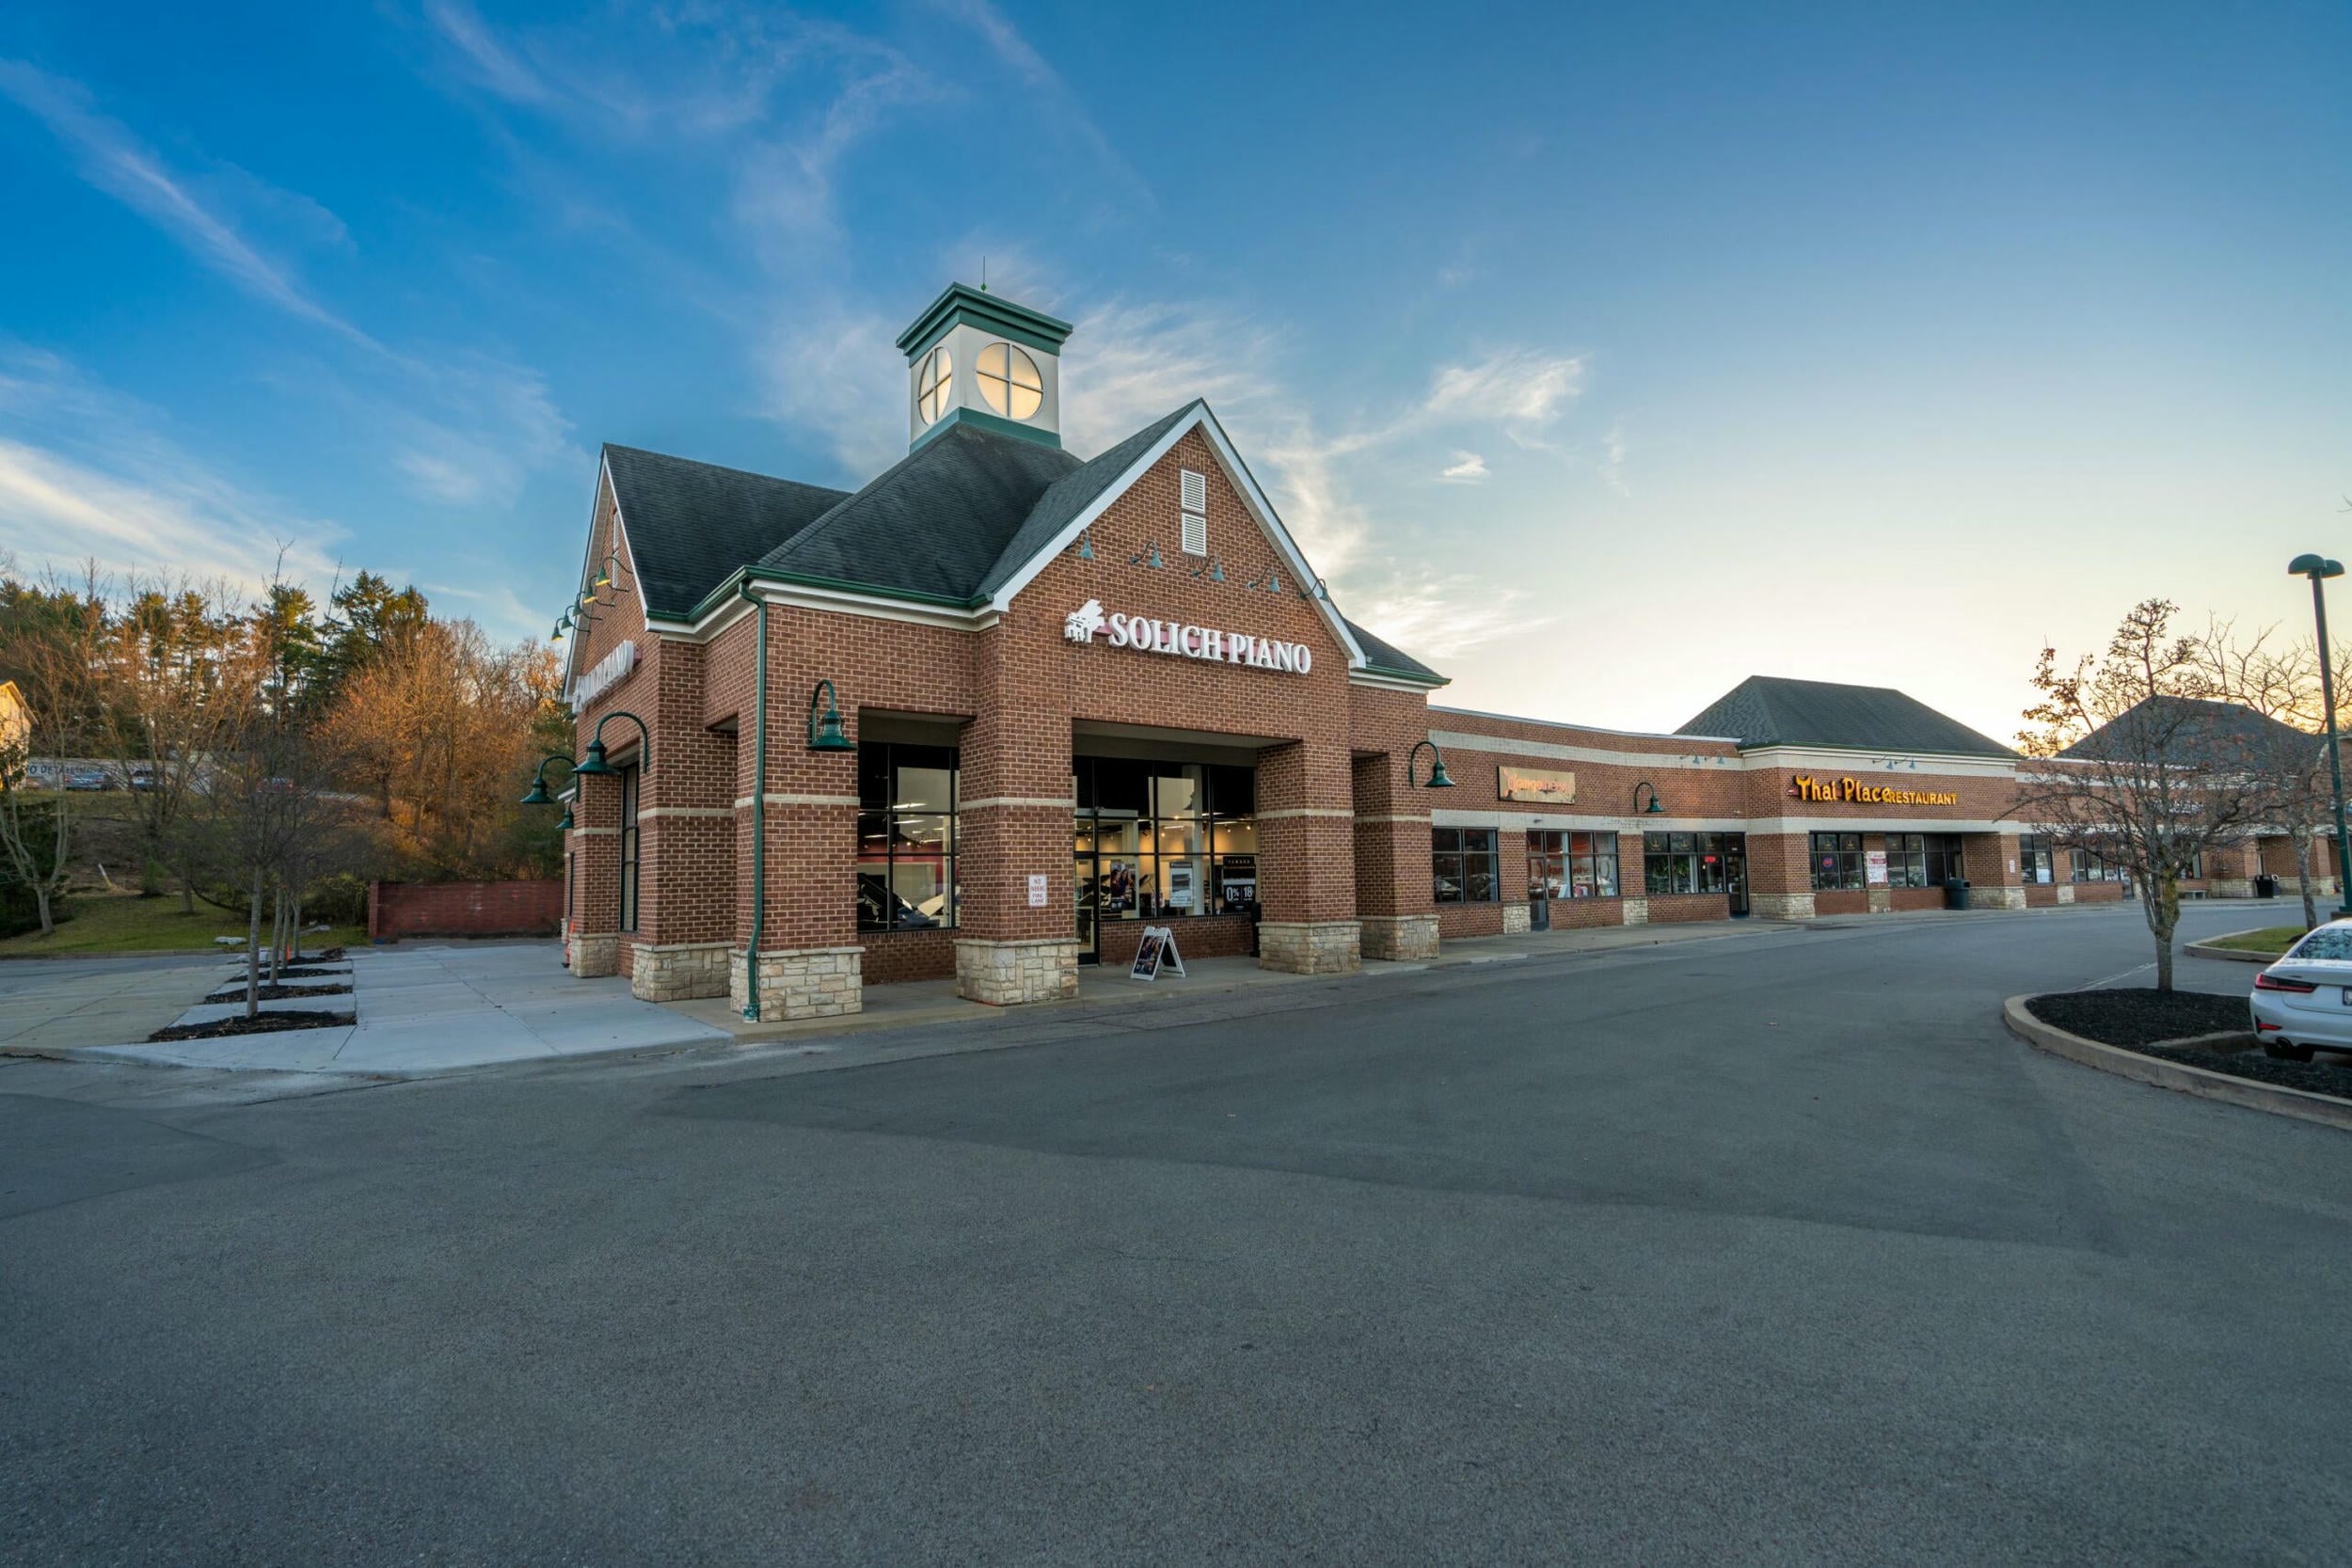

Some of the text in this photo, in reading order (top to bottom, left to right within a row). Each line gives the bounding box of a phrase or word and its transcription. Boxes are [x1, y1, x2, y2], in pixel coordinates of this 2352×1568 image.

[1108, 612, 1311, 674] SOLICH PIANO
[1796, 774, 1957, 805] Thai Place RESTAURANT
